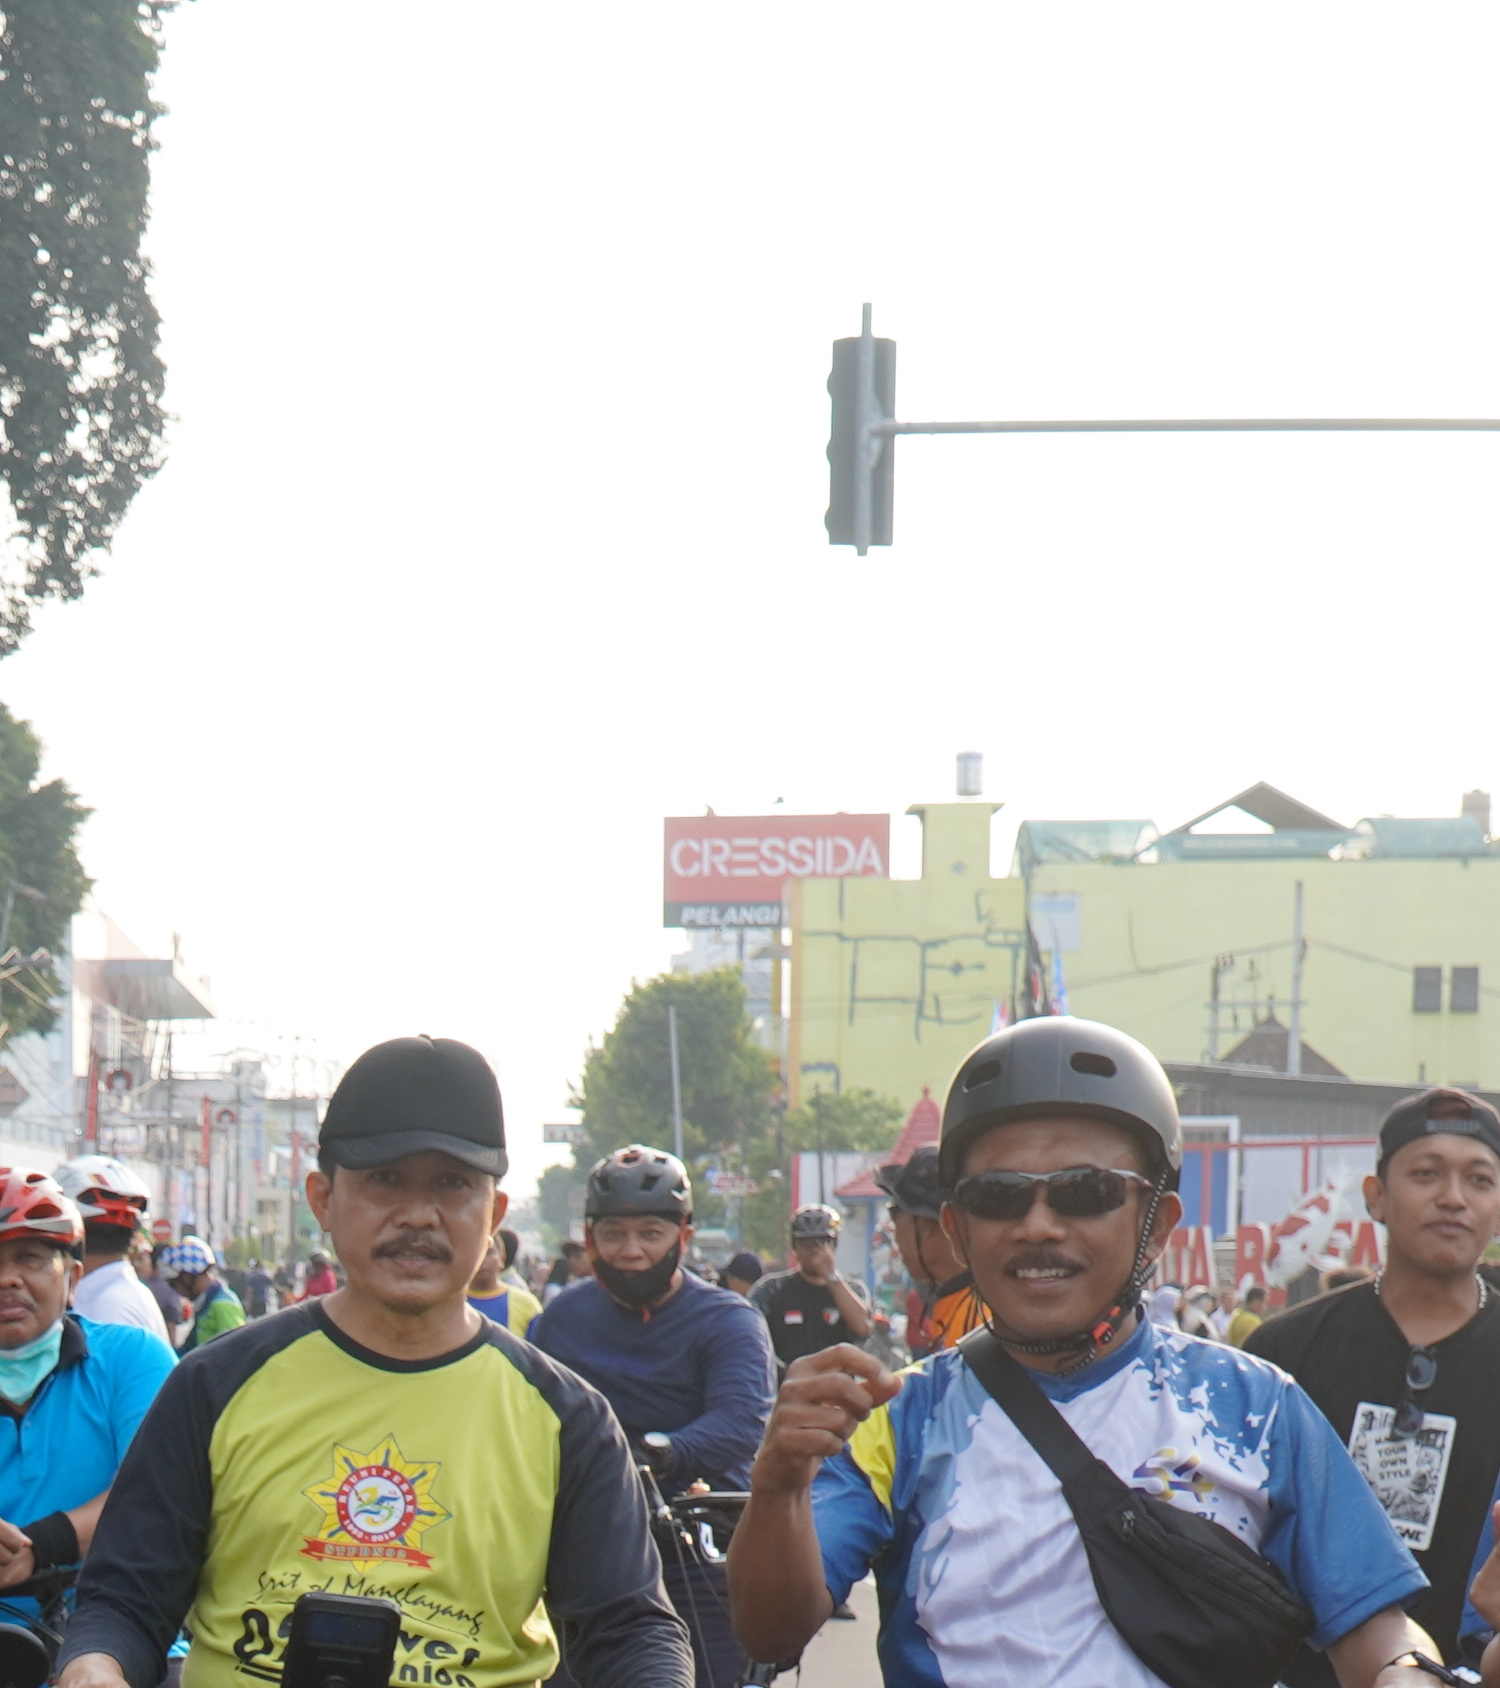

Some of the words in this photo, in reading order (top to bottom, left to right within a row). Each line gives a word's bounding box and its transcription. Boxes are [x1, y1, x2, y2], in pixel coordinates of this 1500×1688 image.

[669, 836, 884, 878] CRESSIDA
[1378, 1469, 1411, 1480] STYLE
[1380, 1458, 1408, 1469] OWN
[338, 1467, 378, 1505] REUNI
